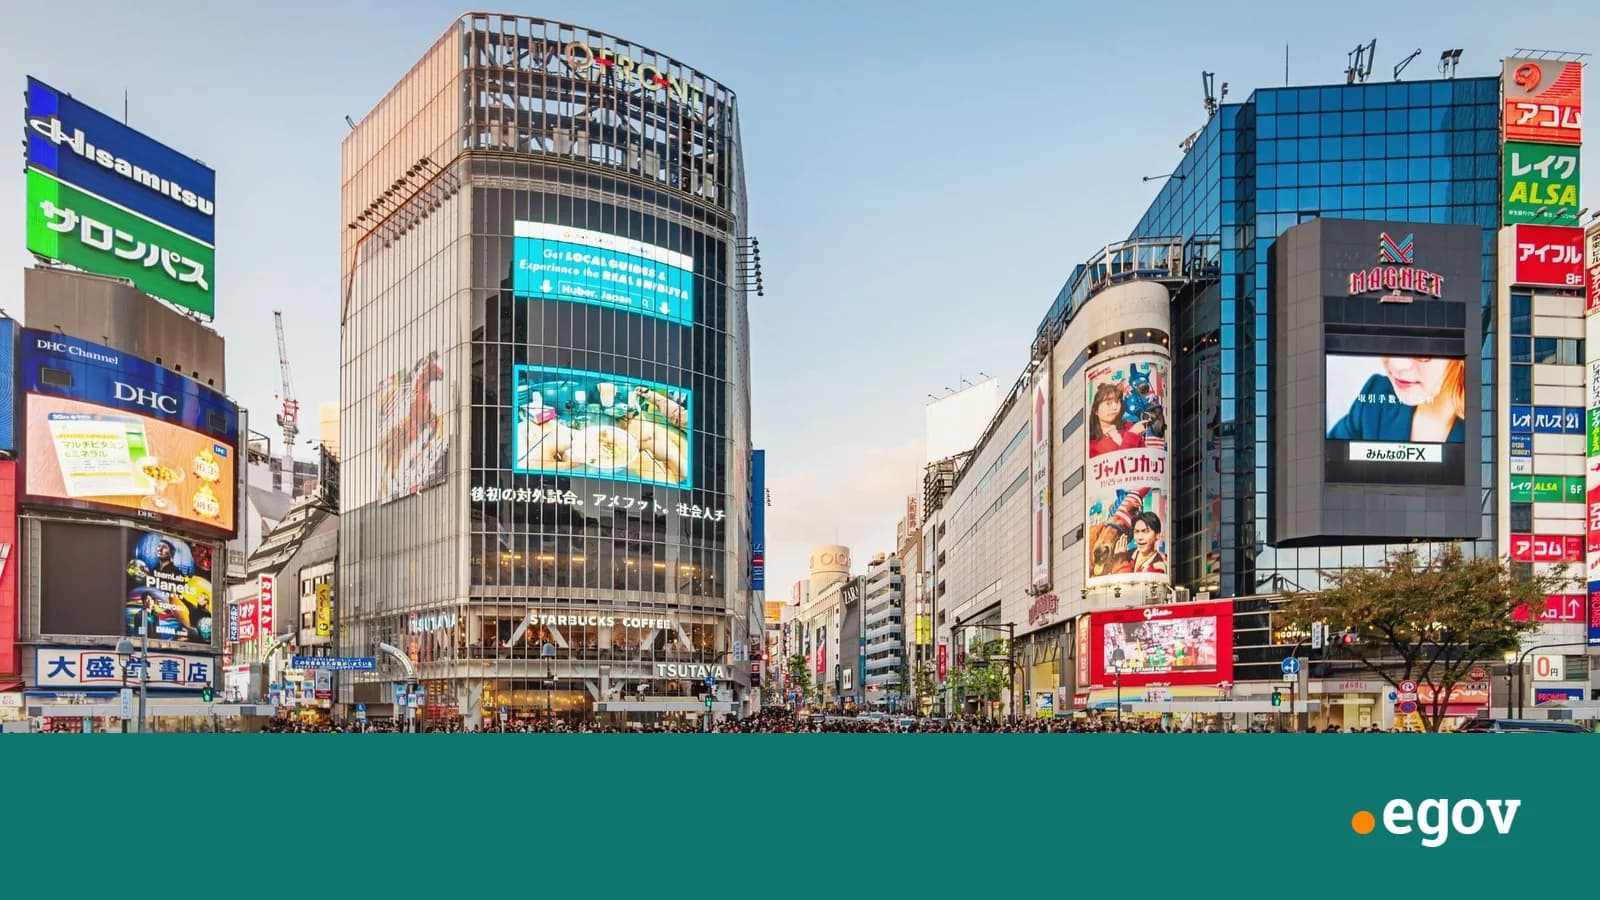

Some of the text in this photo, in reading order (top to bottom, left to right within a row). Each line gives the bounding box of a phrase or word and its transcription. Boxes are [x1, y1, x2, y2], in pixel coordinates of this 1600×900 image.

[1516, 103, 1581, 129] アコム
[30, 118, 214, 216] Hisamitsu
[1511, 152, 1577, 179] レイク
[1509, 181, 1577, 207] ALSA
[40, 199, 209, 290] サロンパス
[1518, 243, 1583, 264] アイフル
[543, 248, 563, 260] Get
[565, 251, 607, 267] LOCAL
[608, 259, 655, 278] GUIDES
[519, 258, 689, 300] Experience the REAL SHIBUYA
[1350, 266, 1444, 299] MAGNET
[1566, 273, 1582, 285] 8F
[37, 338, 118, 365] DHC Channel
[113, 381, 177, 414] DHC
[1366, 447, 1426, 461] みんなのFX
[1511, 481, 1531, 490] レイク
[1534, 482, 1558, 491] ALSA
[1516, 541, 1562, 555] アコム
[146, 575, 197, 595] Planets
[529, 614, 670, 630] STARBUCKS COFFEE
[47, 655, 208, 683] 大盛堂書店
[656, 663, 724, 678] TSUTAYA
